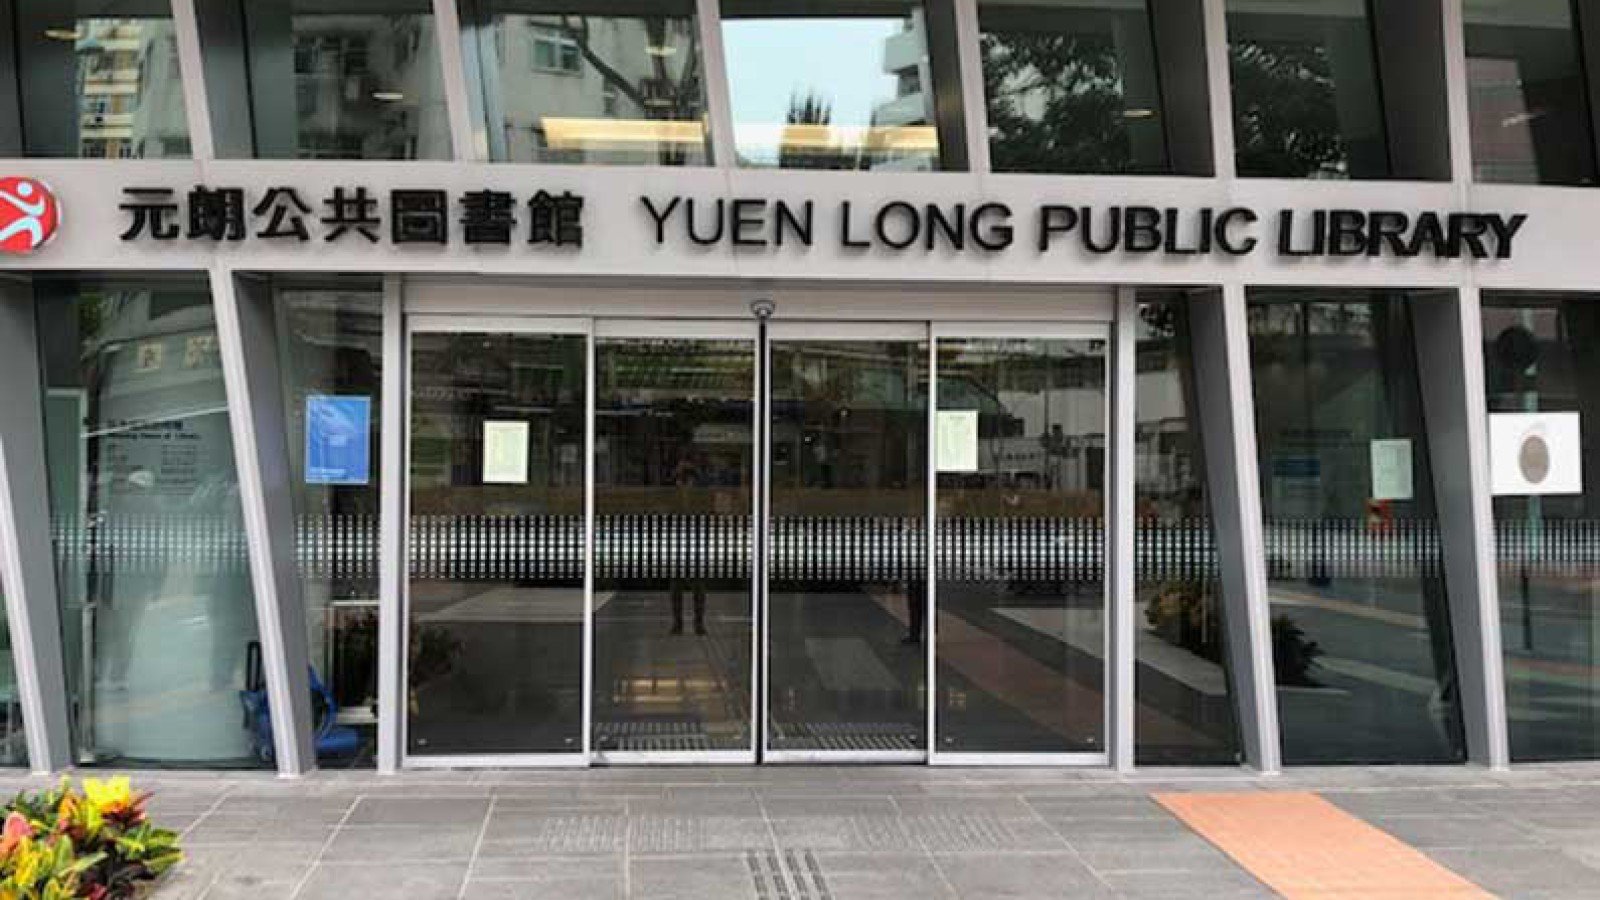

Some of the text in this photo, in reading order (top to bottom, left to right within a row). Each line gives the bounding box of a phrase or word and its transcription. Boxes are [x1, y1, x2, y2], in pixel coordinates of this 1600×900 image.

[119, 185, 584, 248] 元朗公共圖書館
[641, 196, 1528, 260] YUEN LONG PUBLIC LIBRARY
